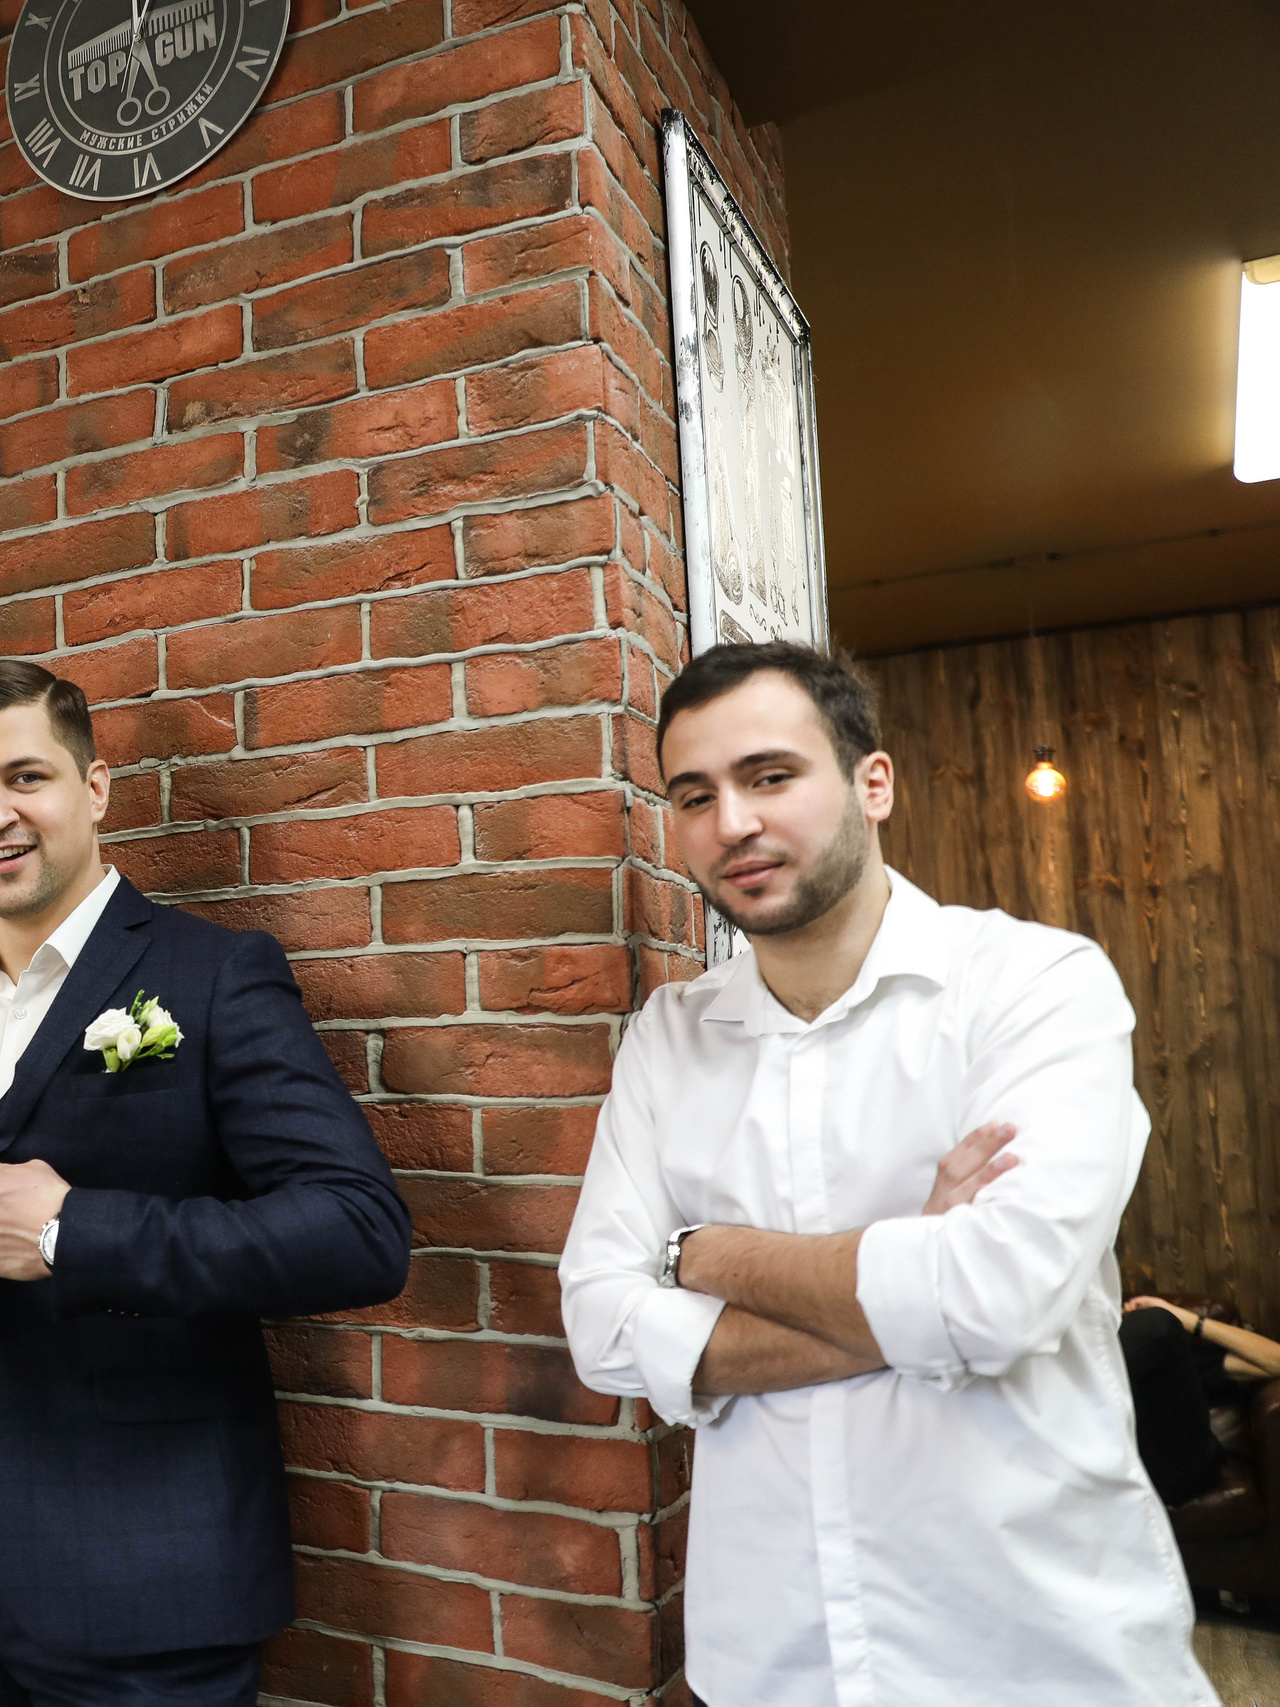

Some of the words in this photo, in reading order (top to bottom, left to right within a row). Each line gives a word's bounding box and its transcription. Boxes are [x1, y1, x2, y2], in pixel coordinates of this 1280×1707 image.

[68, 50, 127, 101] TOP
[154, 13, 217, 67] GUN
[235, 45, 271, 82] IV
[79, 129, 144, 151] МУЖСКИЕ
[150, 83, 214, 141] СТРИЖКИ
[69, 154, 102, 192] VII
[133, 152, 162, 189] VI
